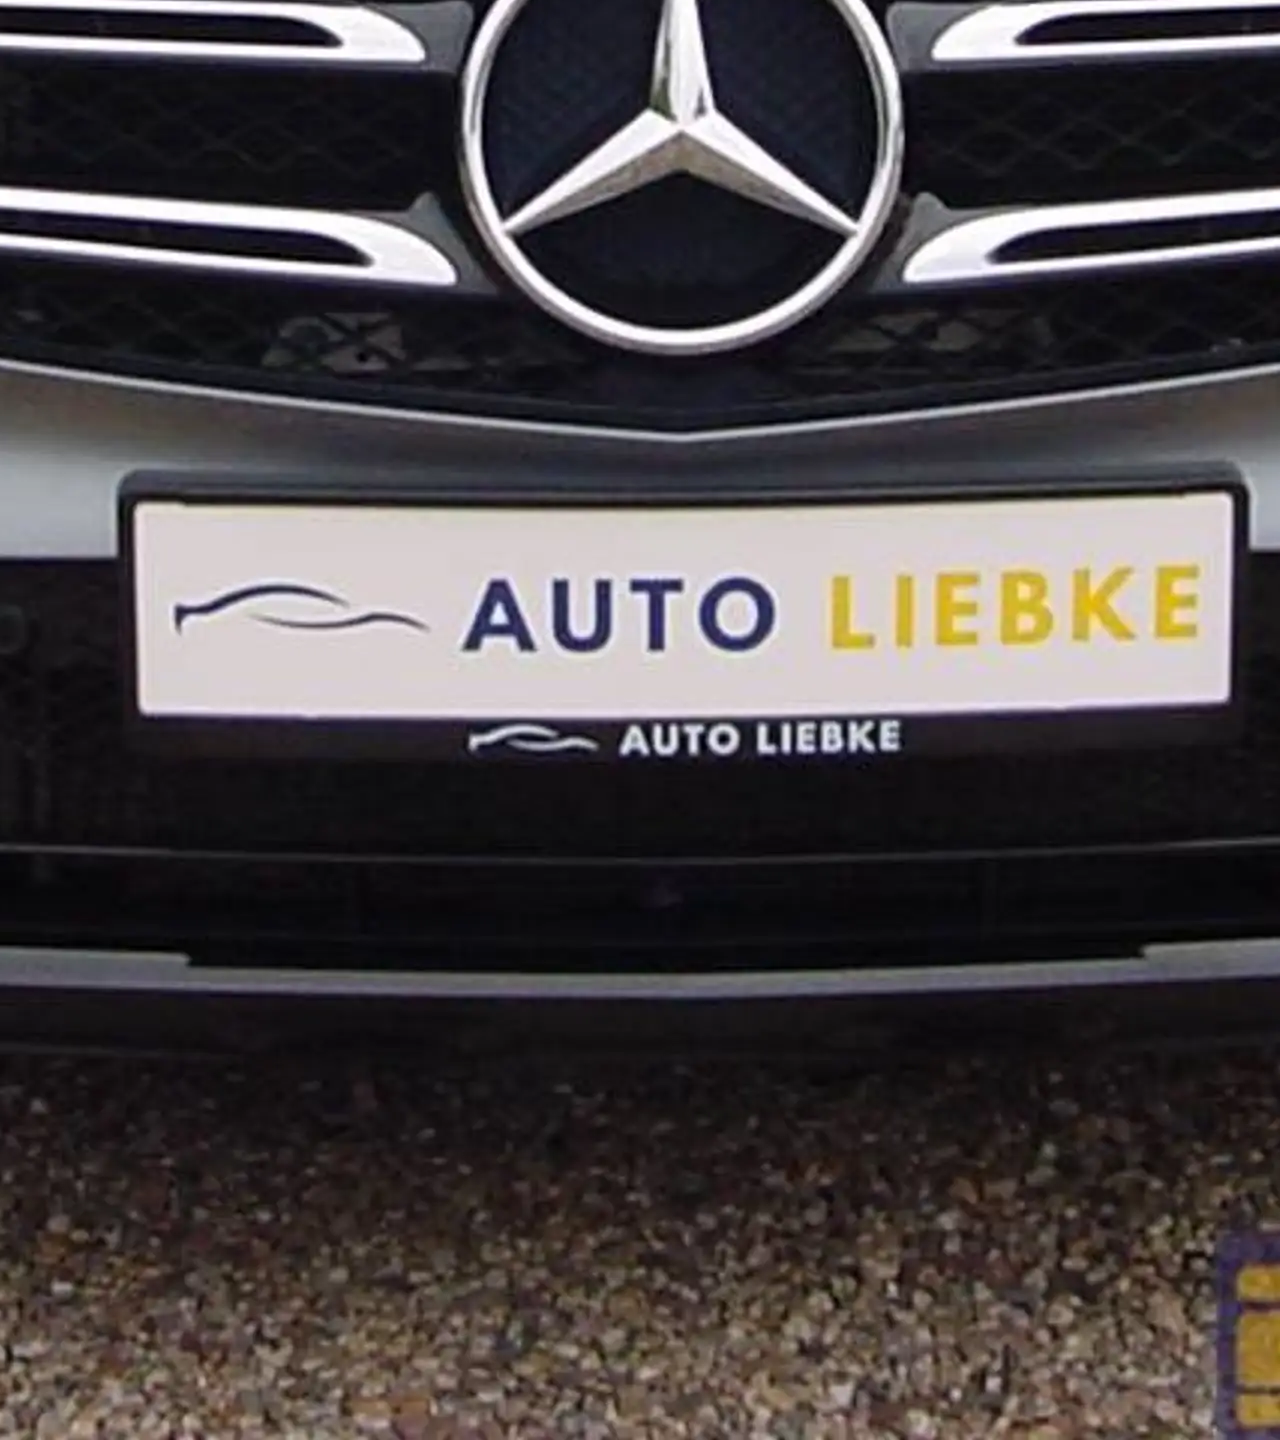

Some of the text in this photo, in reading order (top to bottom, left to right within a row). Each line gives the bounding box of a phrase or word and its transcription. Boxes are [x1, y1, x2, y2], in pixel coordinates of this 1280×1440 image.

[460, 564, 1201, 653] AUTO LIEBKE
[619, 718, 902, 758] AUTO LIEBKE
